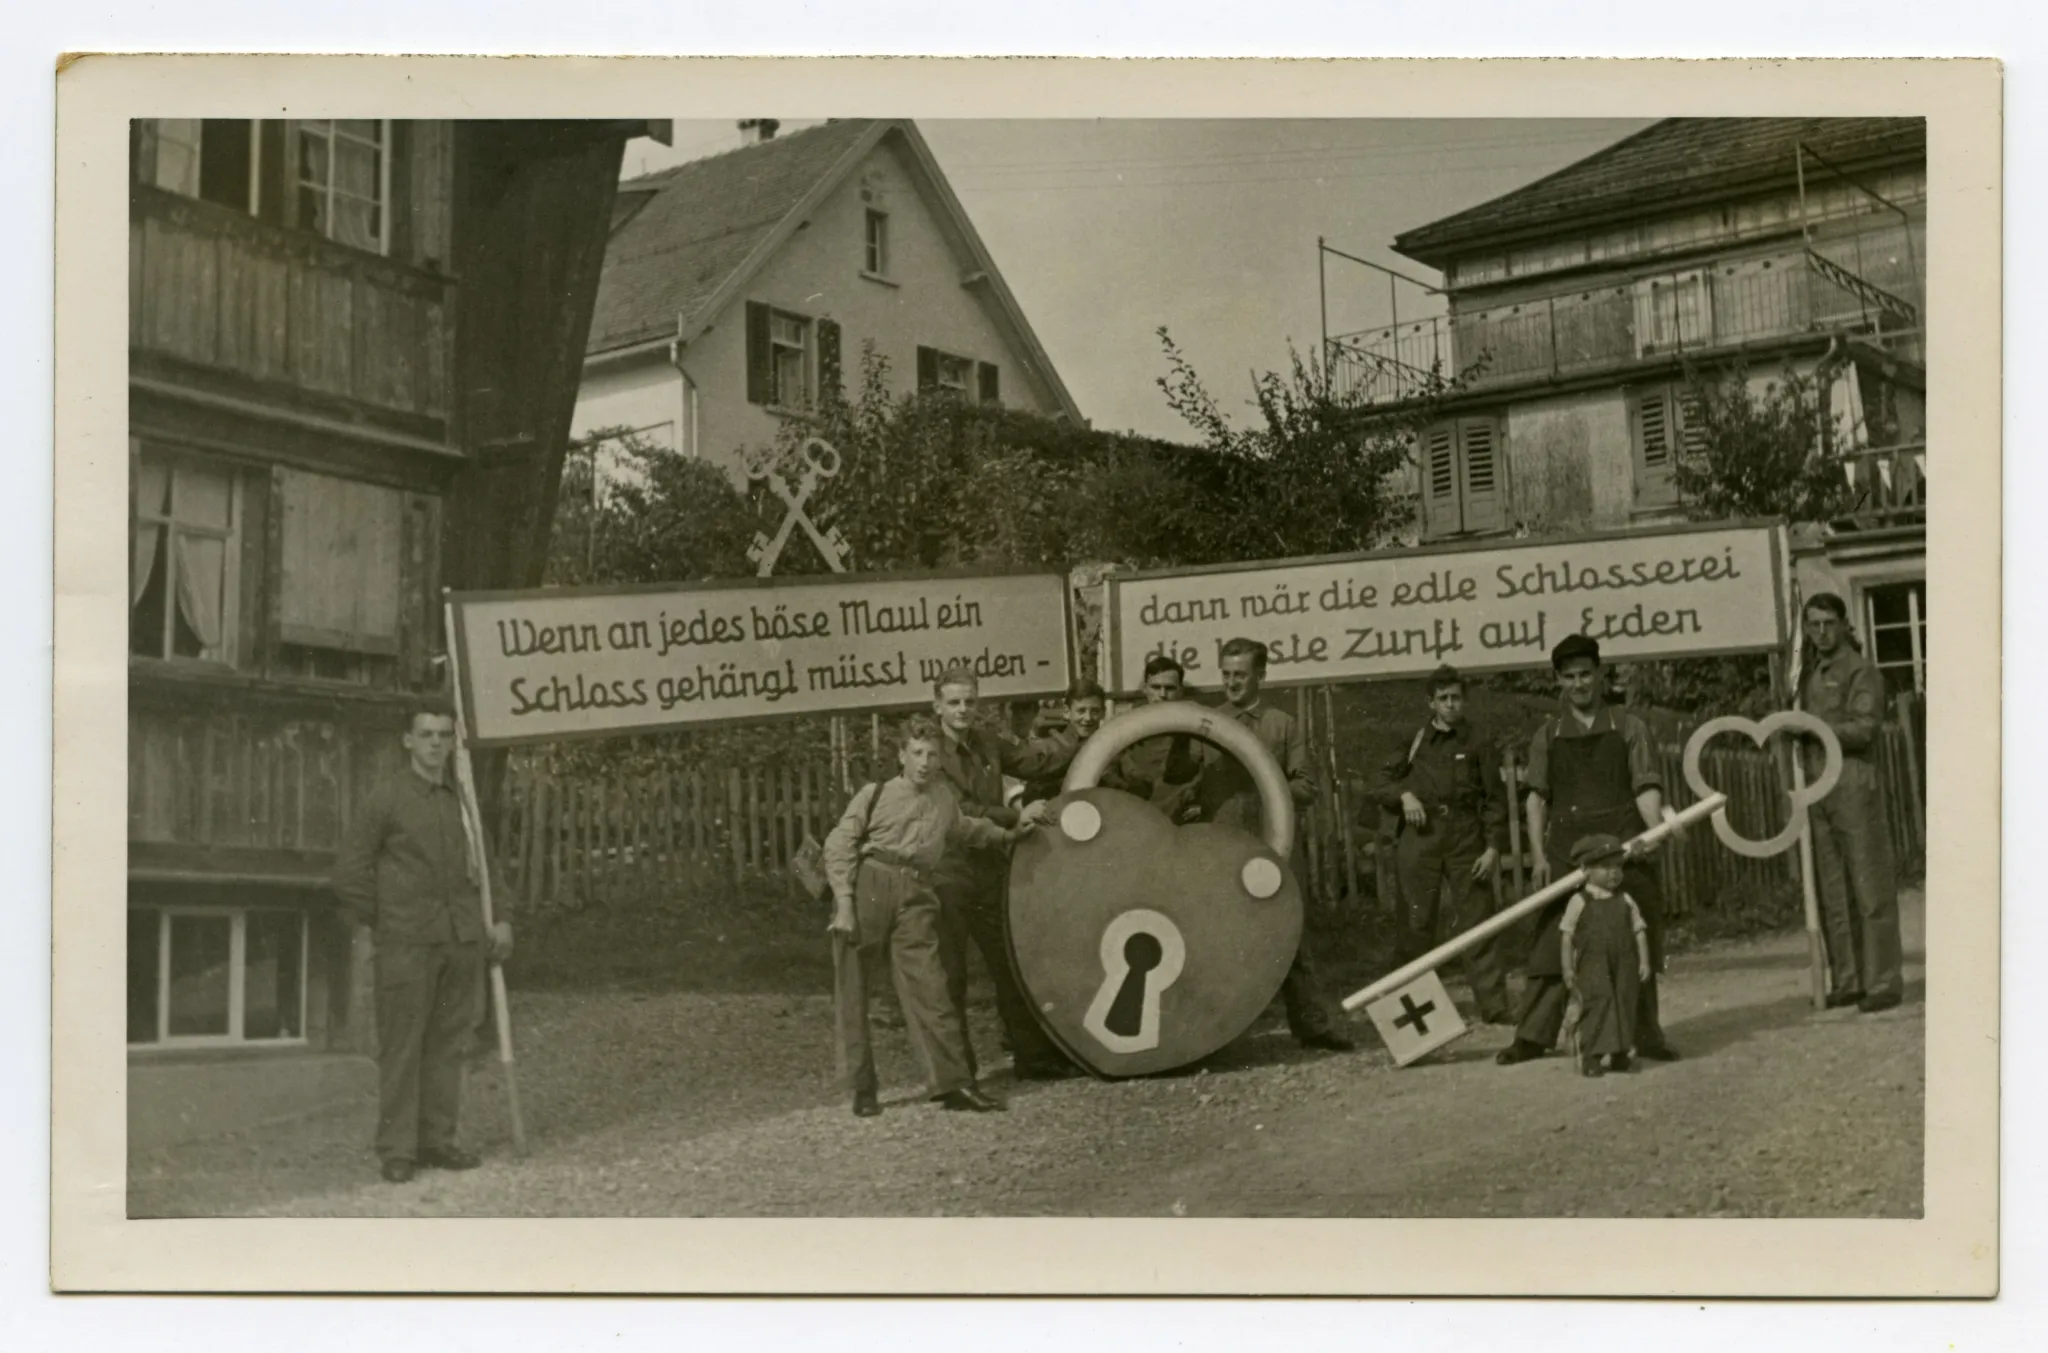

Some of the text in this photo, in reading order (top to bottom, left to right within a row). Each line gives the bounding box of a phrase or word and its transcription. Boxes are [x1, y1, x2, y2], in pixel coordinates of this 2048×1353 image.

[1140, 546, 1740, 626] dann wär die edle Schlosserei
[497, 595, 982, 657] Wenn an jedes böse Maul ein
[1215, 633, 1329, 668] ste
[1340, 617, 1463, 661] Zunft
[1479, 611, 1546, 651] auf
[1580, 603, 1702, 640] Erden
[510, 674, 648, 716] Schloss
